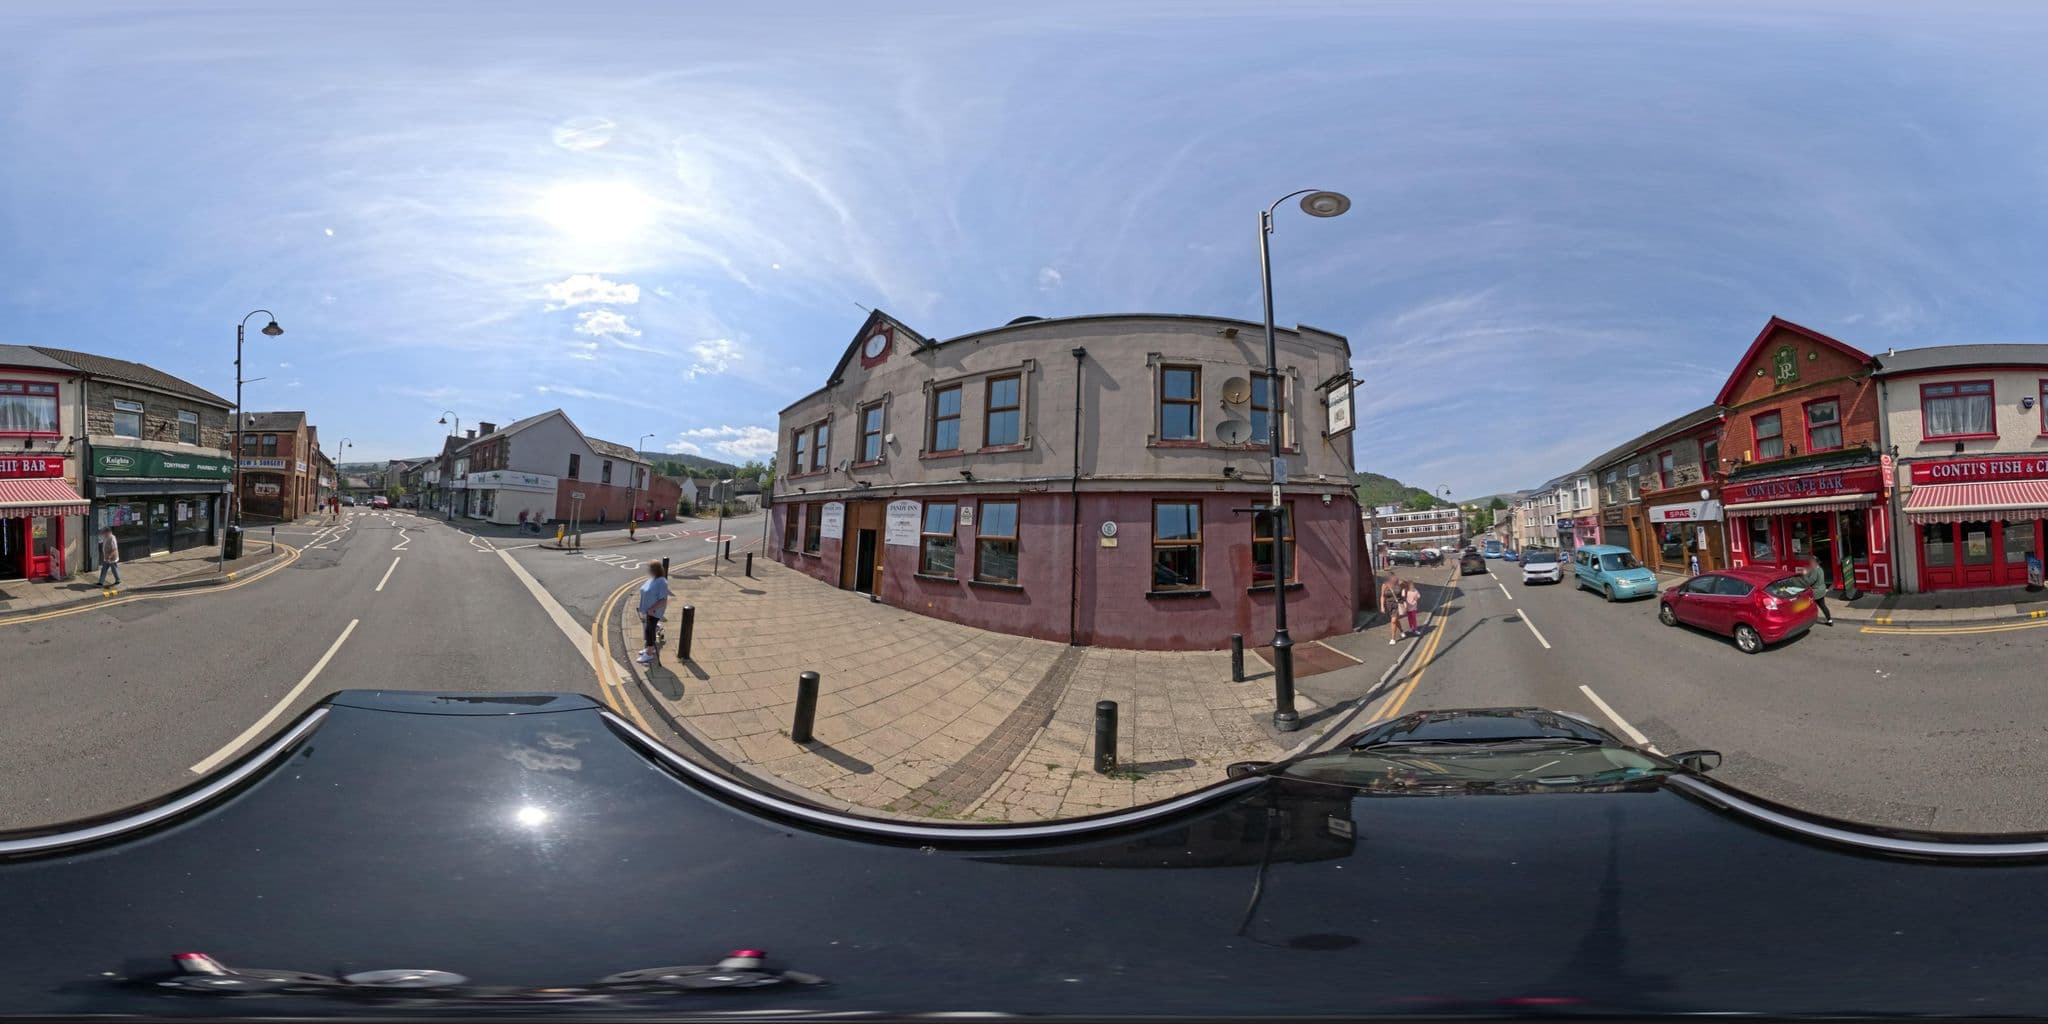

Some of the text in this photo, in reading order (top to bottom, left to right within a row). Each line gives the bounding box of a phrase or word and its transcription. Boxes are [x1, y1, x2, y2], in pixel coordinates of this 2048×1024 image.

[22, 460, 46, 472] BAR
[106, 456, 129, 466] Knights
[1932, 463, 1987, 478] CONTI'S
[1990, 461, 2022, 474] FISH
[2026, 463, 2033, 473] &
[1745, 481, 1785, 497] CONTI'S
[1819, 476, 1843, 490] BAR
[1668, 510, 1689, 518] SPAR
